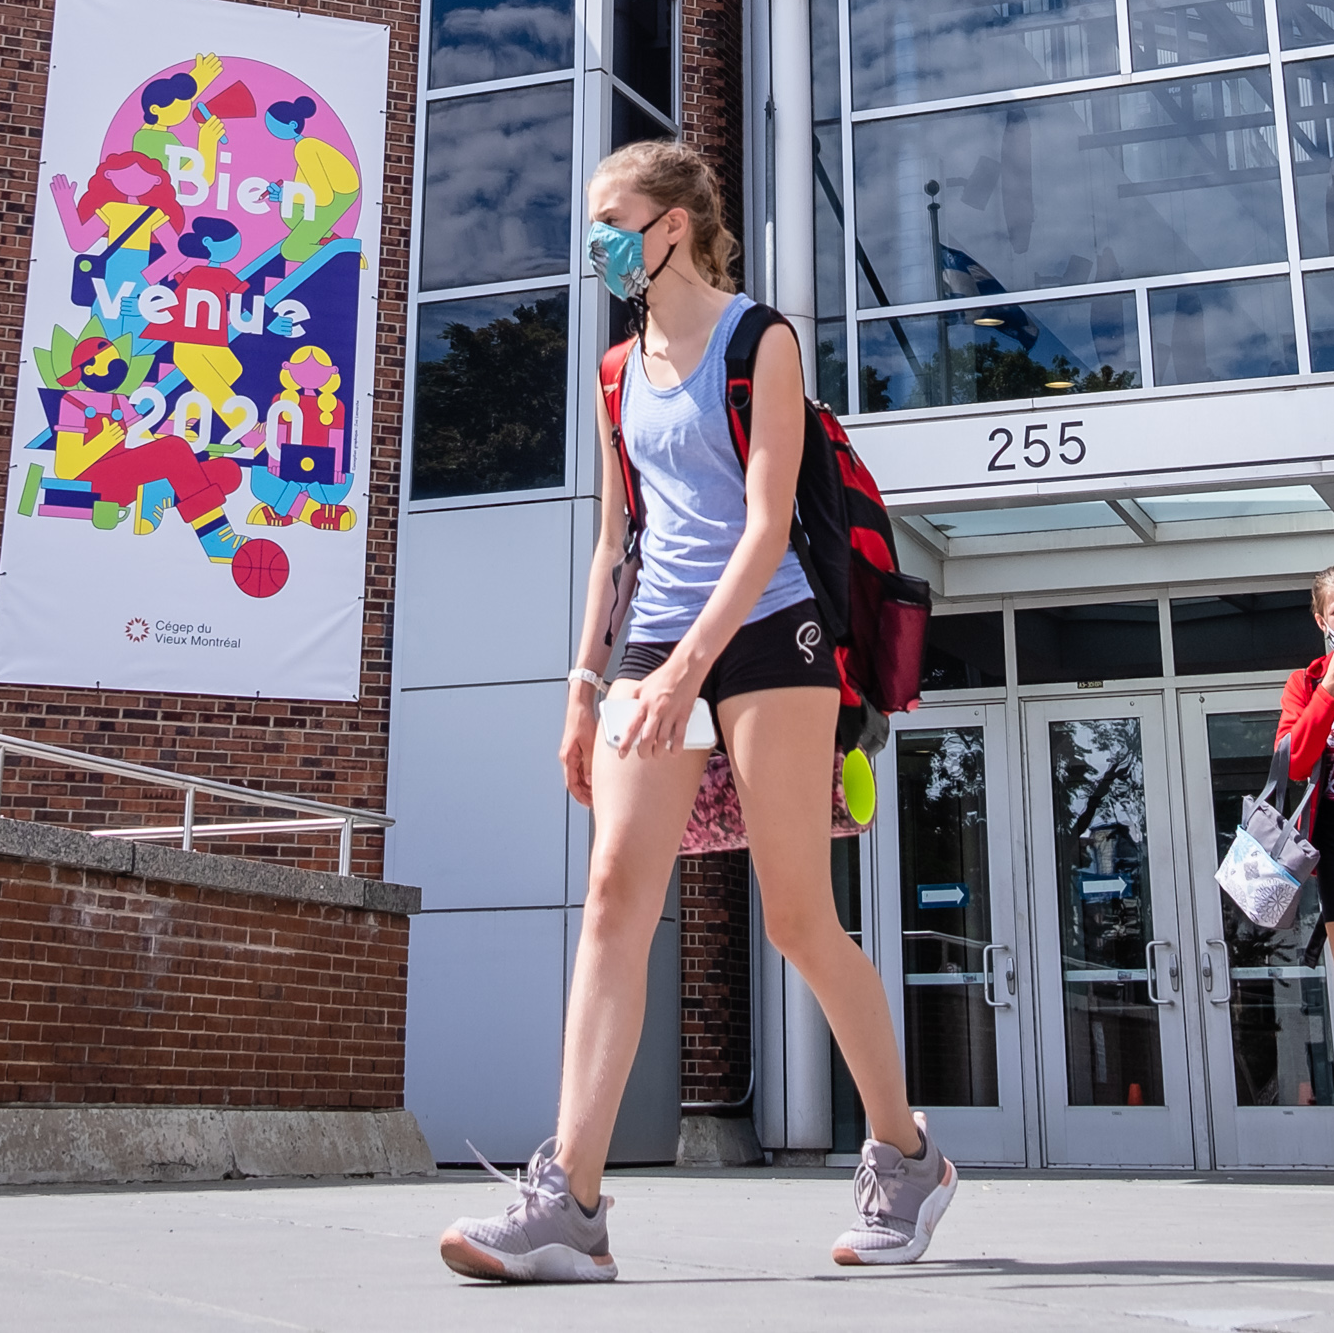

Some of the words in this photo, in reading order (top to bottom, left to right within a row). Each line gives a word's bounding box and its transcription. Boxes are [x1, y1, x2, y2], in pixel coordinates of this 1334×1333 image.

[165, 144, 316, 221] Bien
[91, 277, 311, 338] venue
[125, 386, 304, 462] 2020
[988, 421, 1087, 472] 255
[155, 620, 194, 634] Cégep
[197, 623, 212, 634] du
[155, 633, 187, 645] Vieux
[191, 635, 241, 648] Montréal
